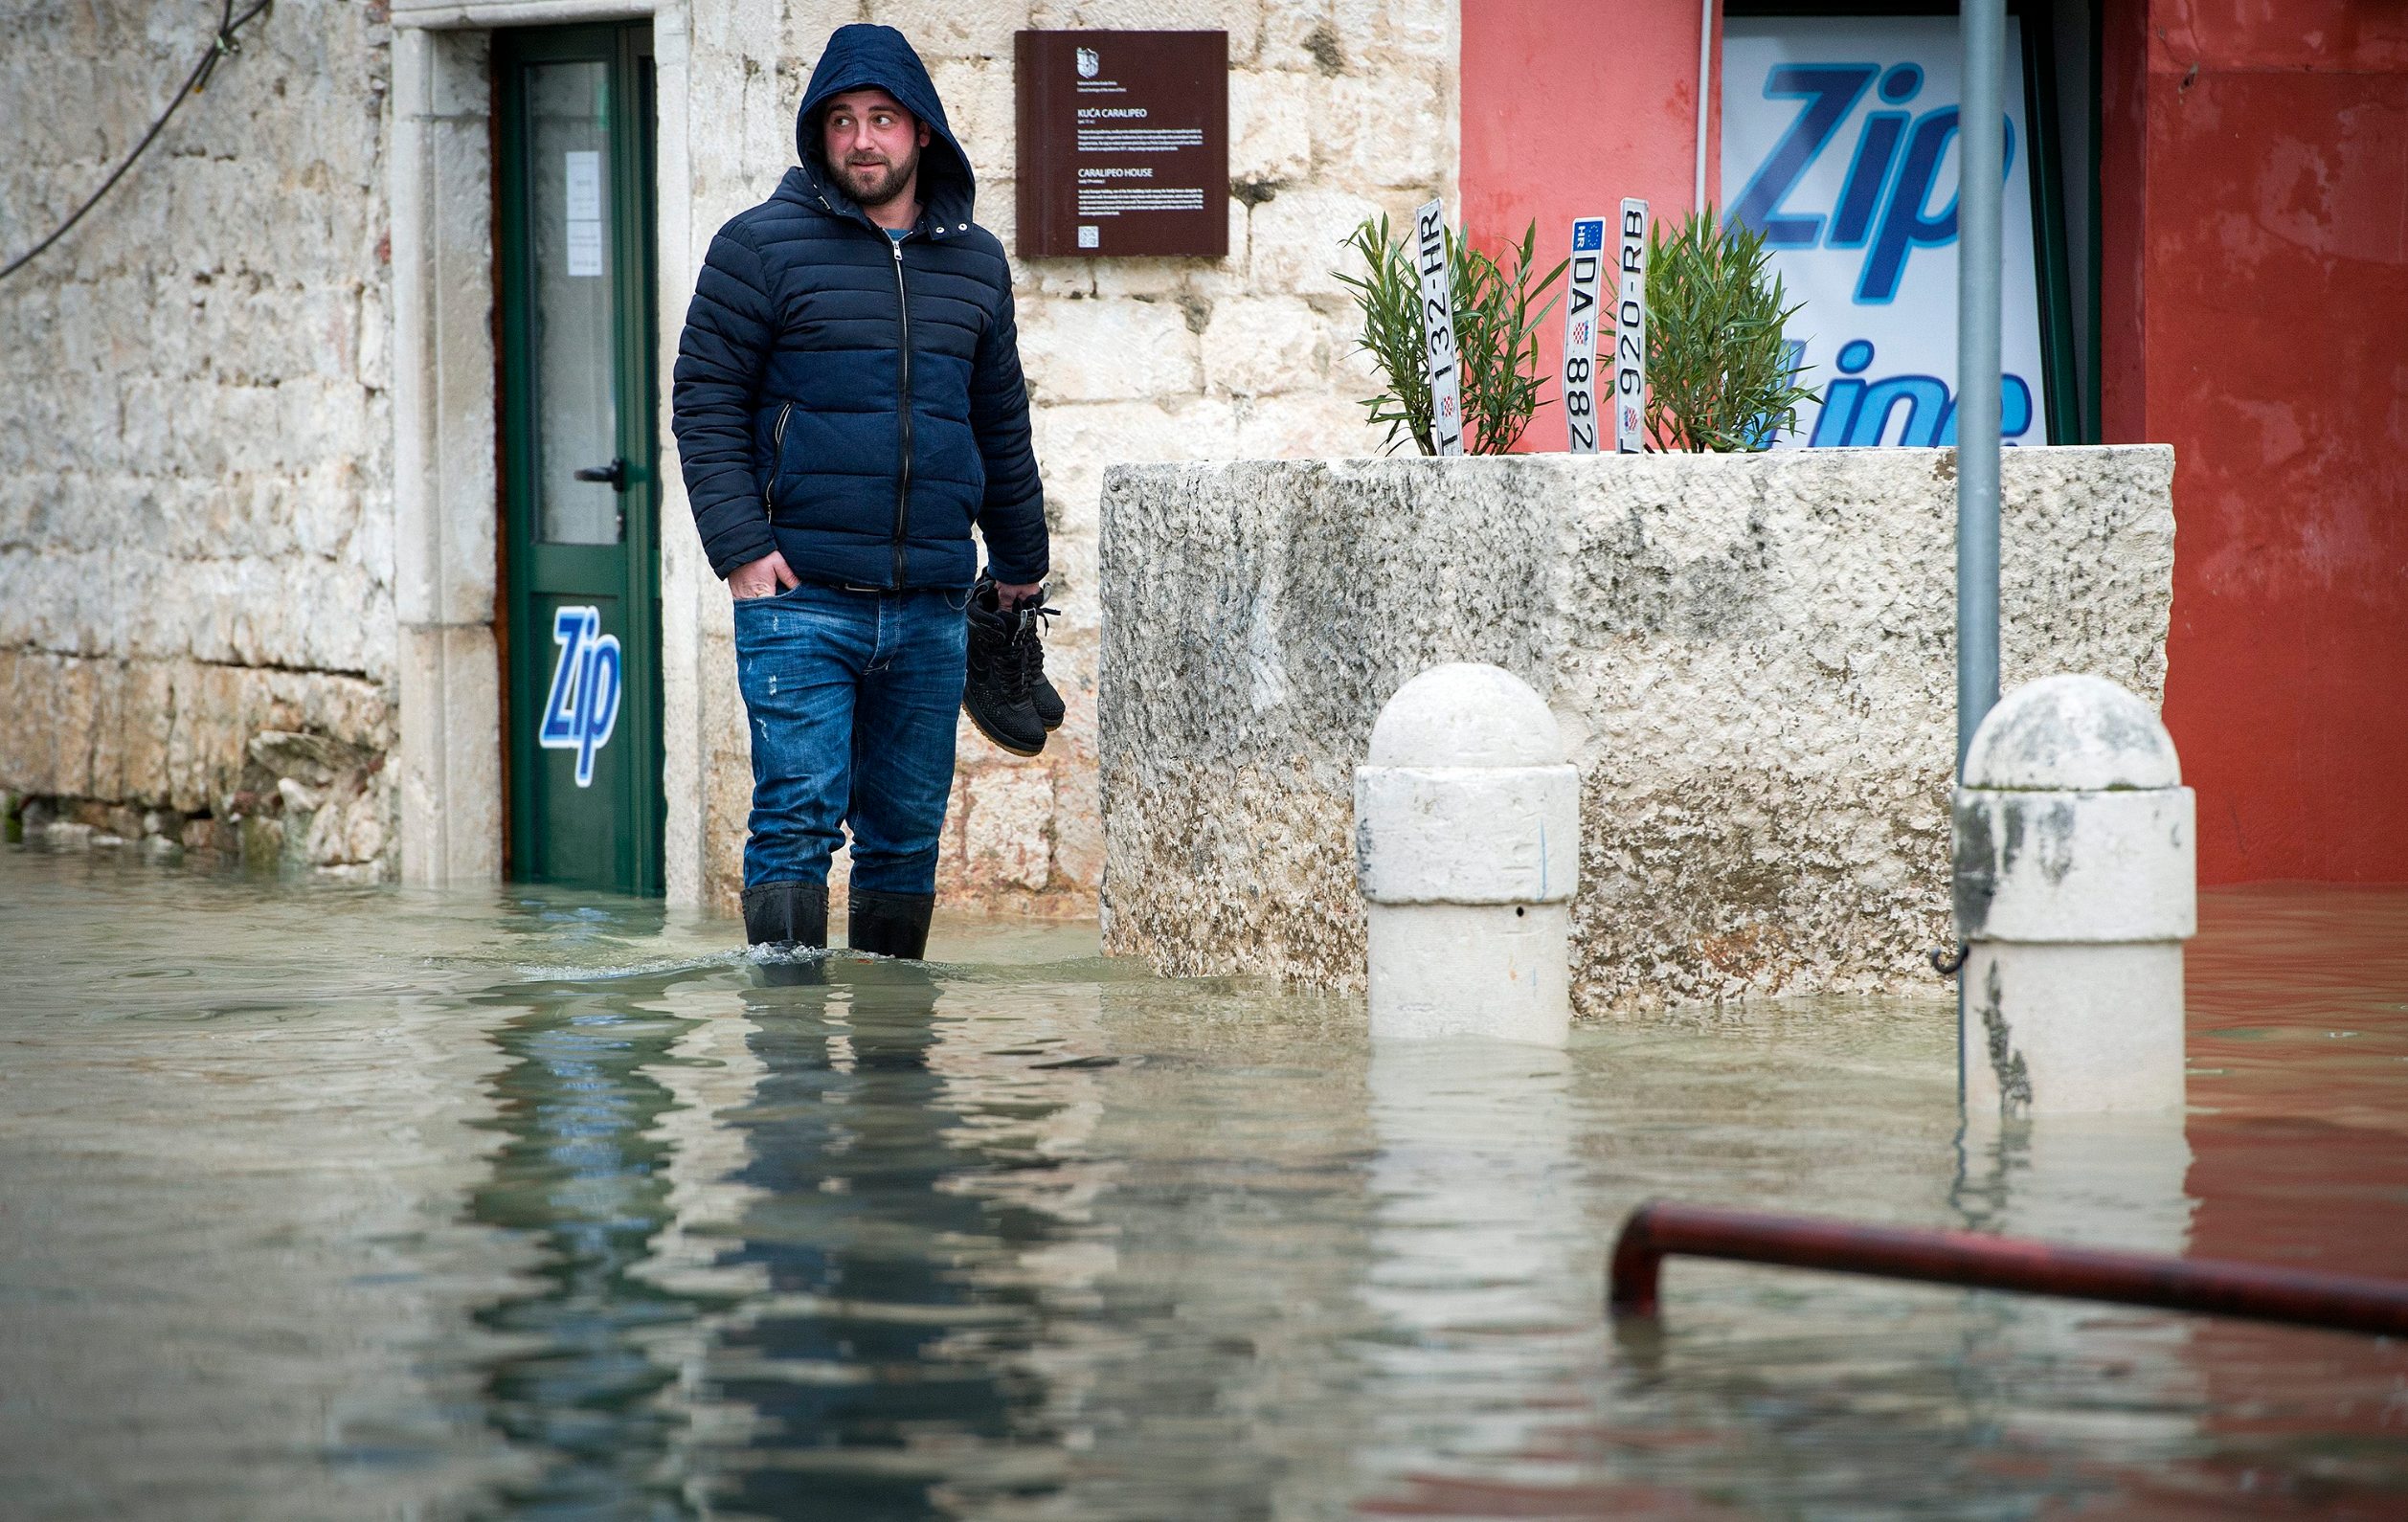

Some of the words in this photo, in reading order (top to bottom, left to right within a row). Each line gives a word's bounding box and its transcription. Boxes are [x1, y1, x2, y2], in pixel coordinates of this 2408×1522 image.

[1077, 108, 1101, 118] KUĆA
[1102, 109, 1147, 118] CARALIPEO
[1078, 168, 1123, 177] CARALIPEO
[1124, 168, 1153, 177] HOUSE
[1722, 62, 2015, 305] Zip
[1571, 257, 1596, 315] DA
[1577, 225, 1586, 248] HR
[1420, 210, 1452, 382] 132-HR
[1619, 210, 1643, 396] 920-RB
[1566, 357, 1594, 451] 882
[1739, 339, 2034, 447] in
[539, 606, 621, 788] Zip
